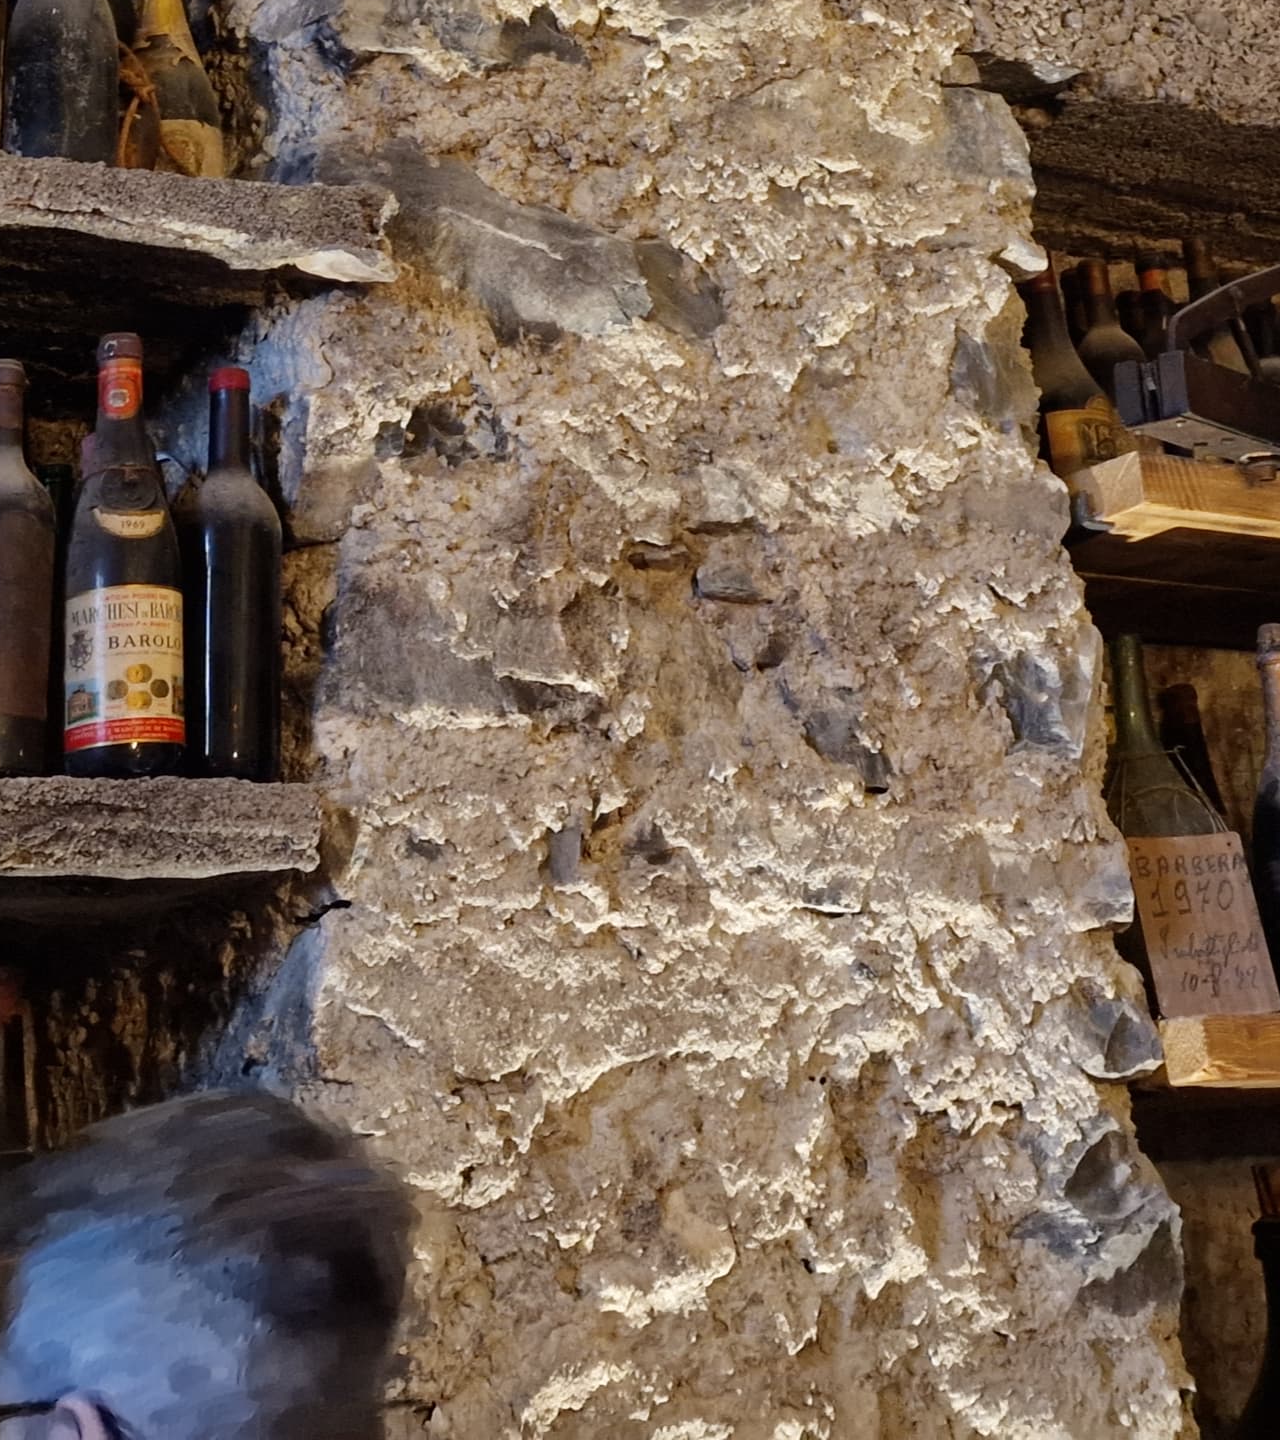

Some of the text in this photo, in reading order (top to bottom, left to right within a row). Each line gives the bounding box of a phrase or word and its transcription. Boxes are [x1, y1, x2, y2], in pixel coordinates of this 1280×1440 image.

[71, 601, 139, 626] MARHESI
[108, 634, 181, 650] BAROLO
[1135, 852, 1245, 877] BARBERA
